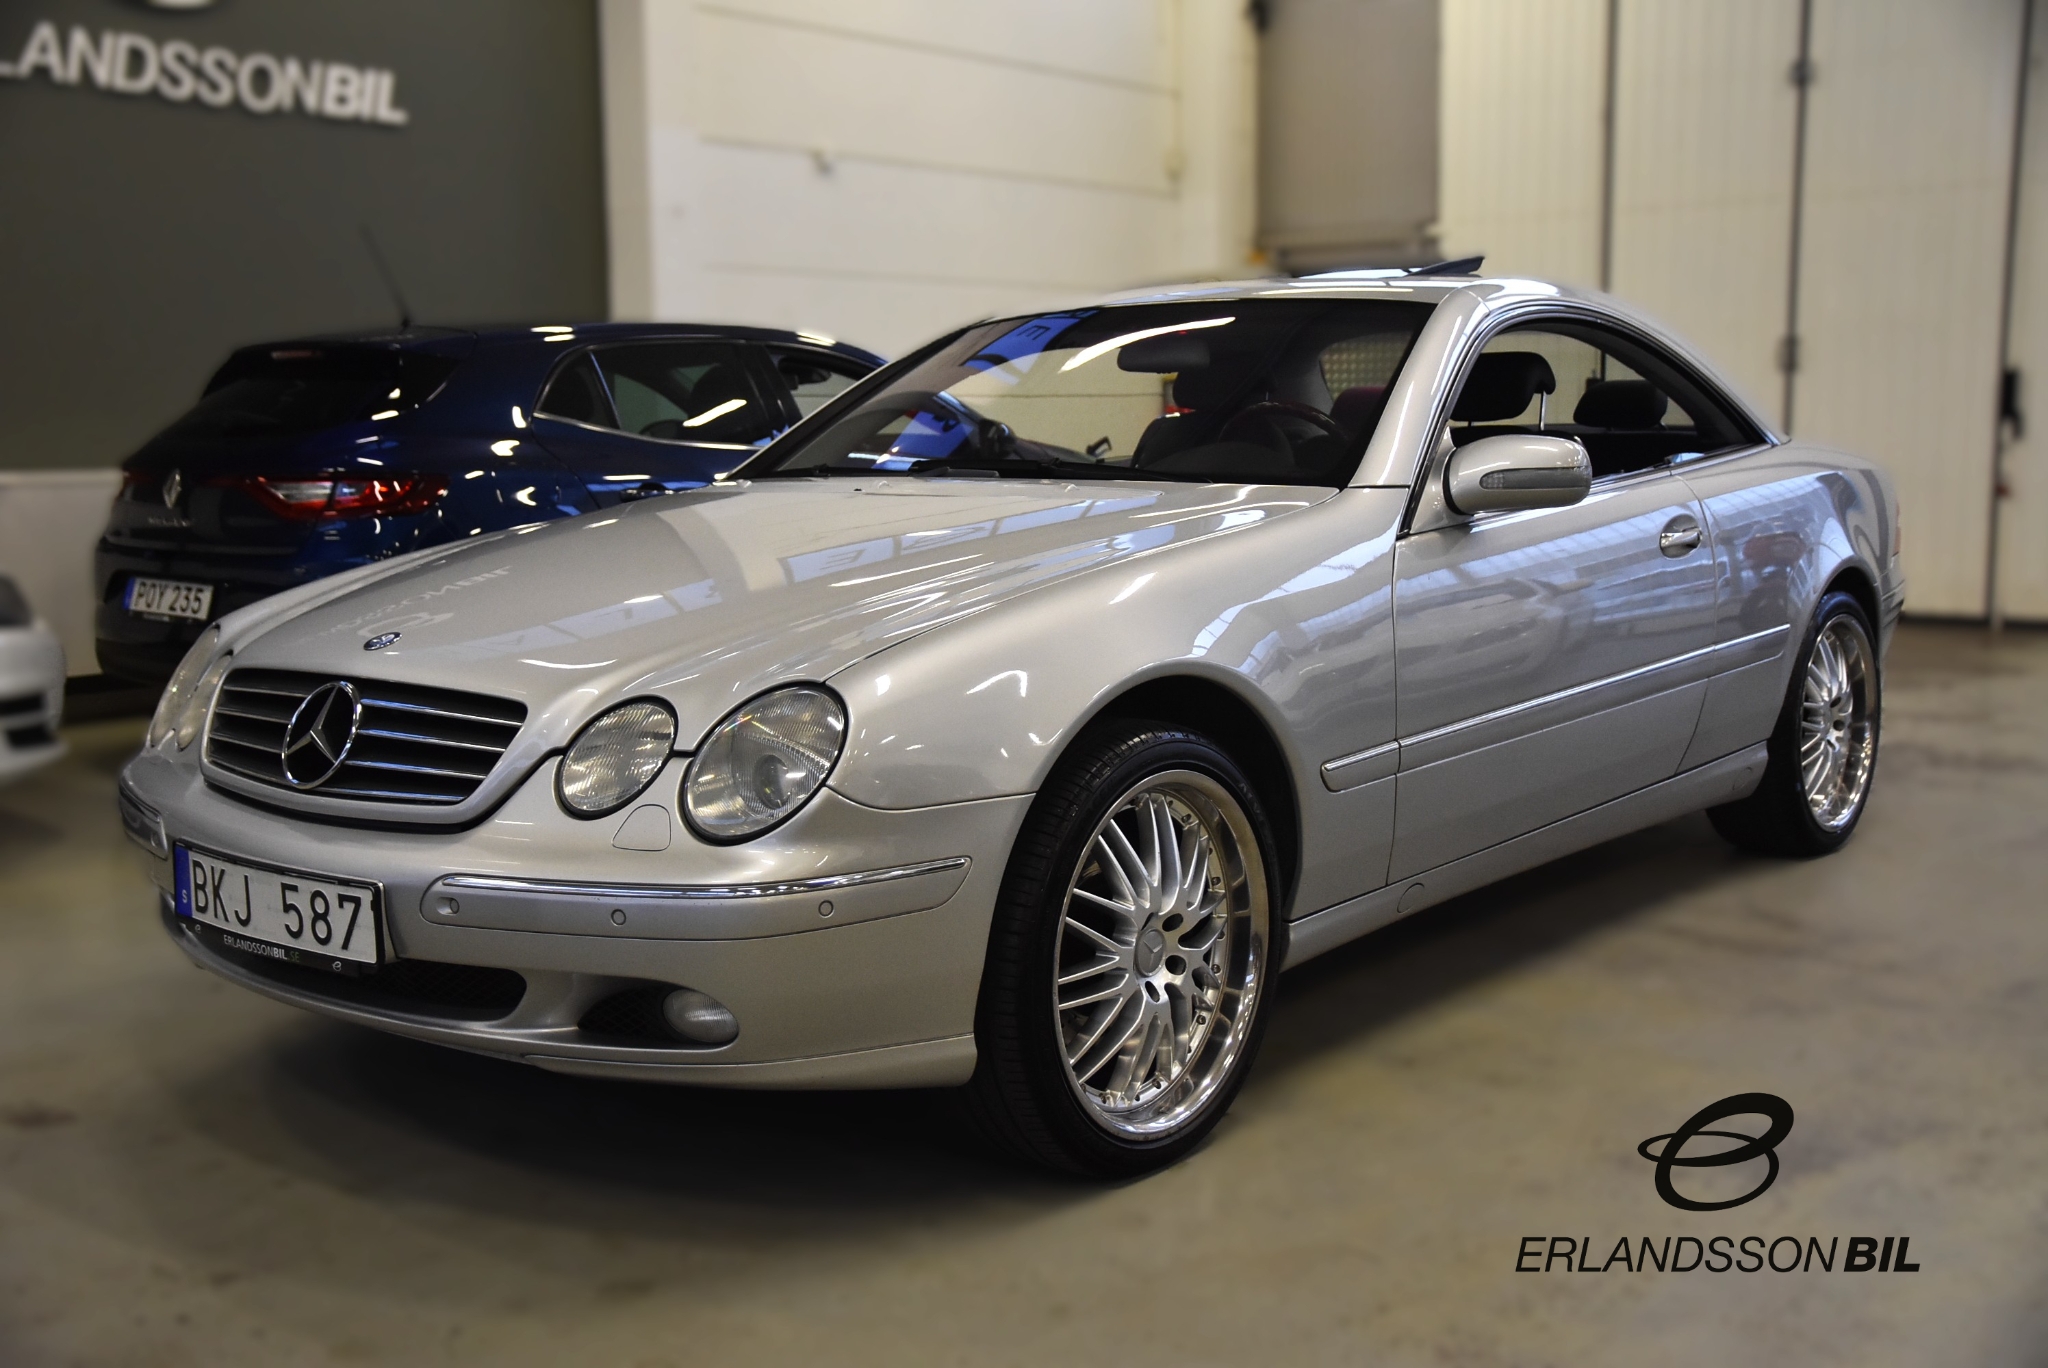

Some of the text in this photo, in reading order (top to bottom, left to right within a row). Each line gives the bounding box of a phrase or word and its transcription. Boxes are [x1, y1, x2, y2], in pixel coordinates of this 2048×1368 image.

[168, 585, 204, 614] 235
[192, 858, 362, 951] BKJ 587
